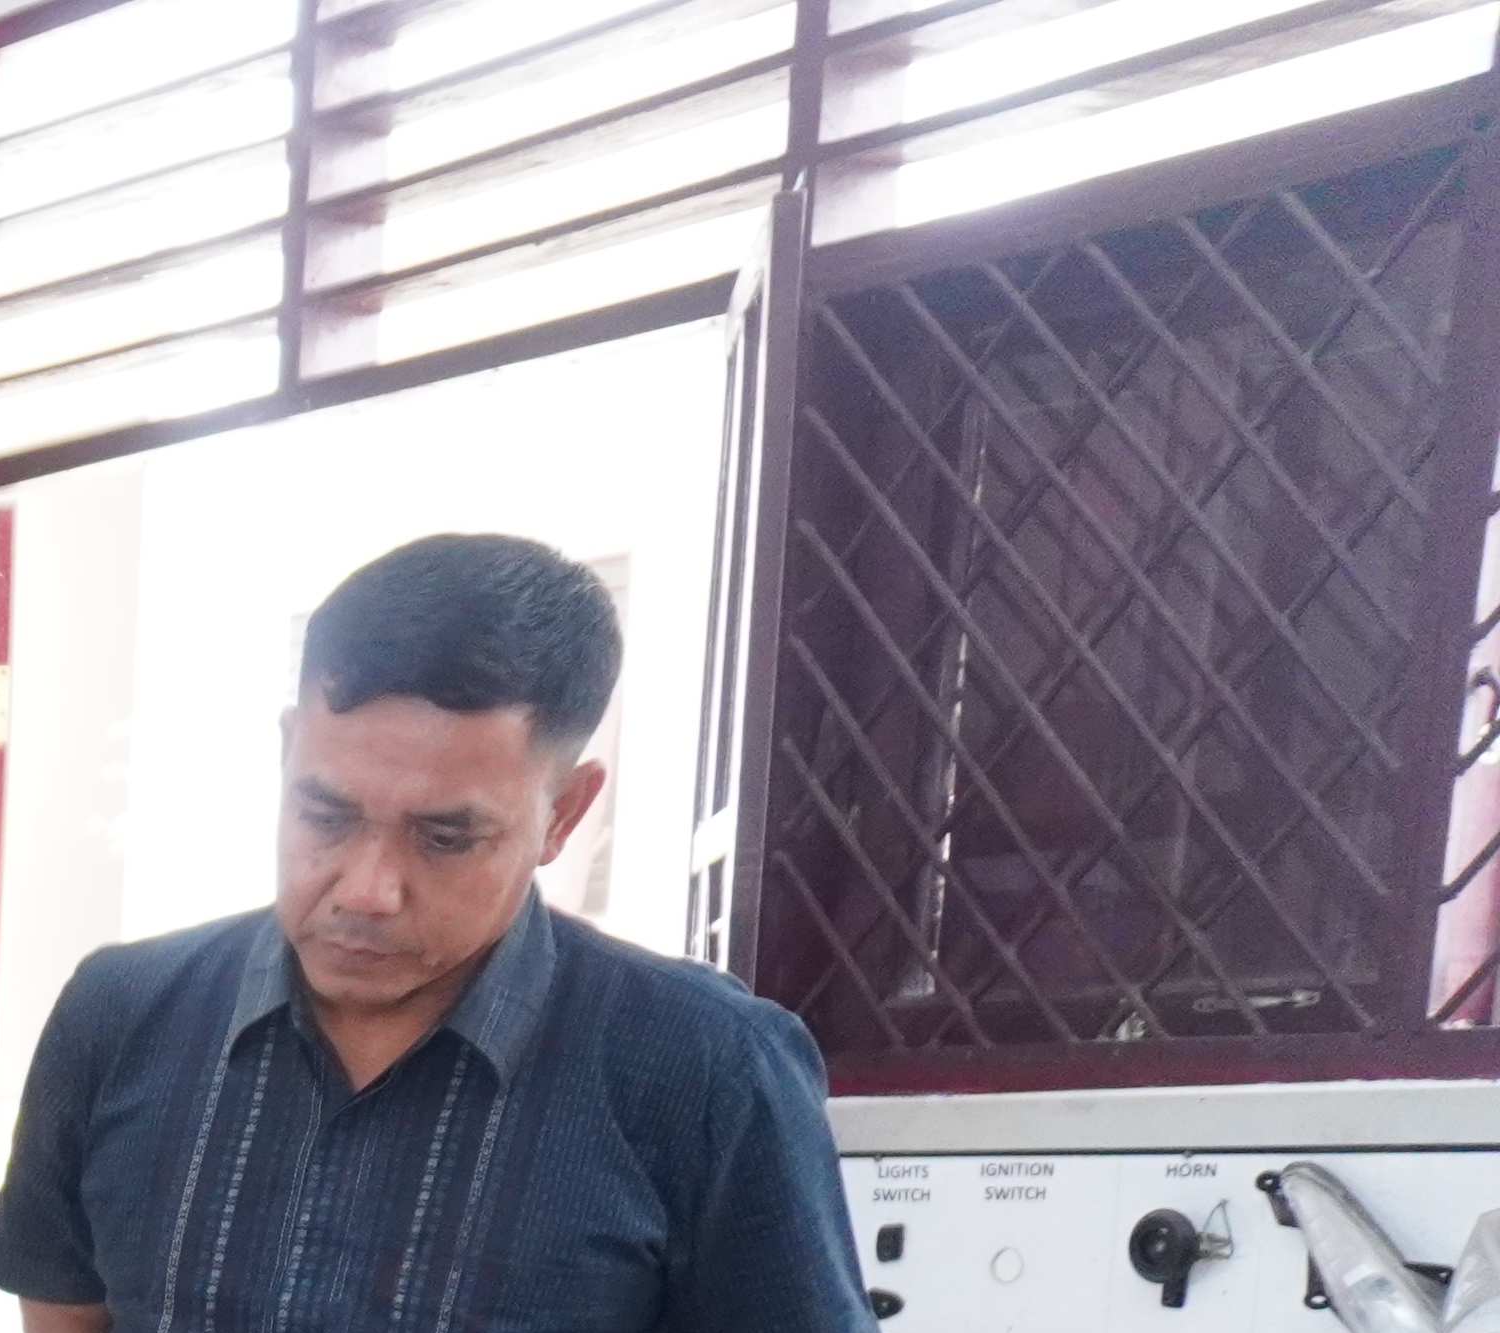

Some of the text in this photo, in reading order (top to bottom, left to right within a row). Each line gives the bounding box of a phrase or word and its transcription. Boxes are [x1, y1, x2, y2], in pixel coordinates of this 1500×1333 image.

[877, 1164, 930, 1179] LIGHTS
[979, 1161, 1055, 1178] IGNITION
[1165, 1162, 1218, 1178] HORN
[872, 1187, 931, 1202] SWITCH
[983, 1185, 1047, 1201] SWITCH
